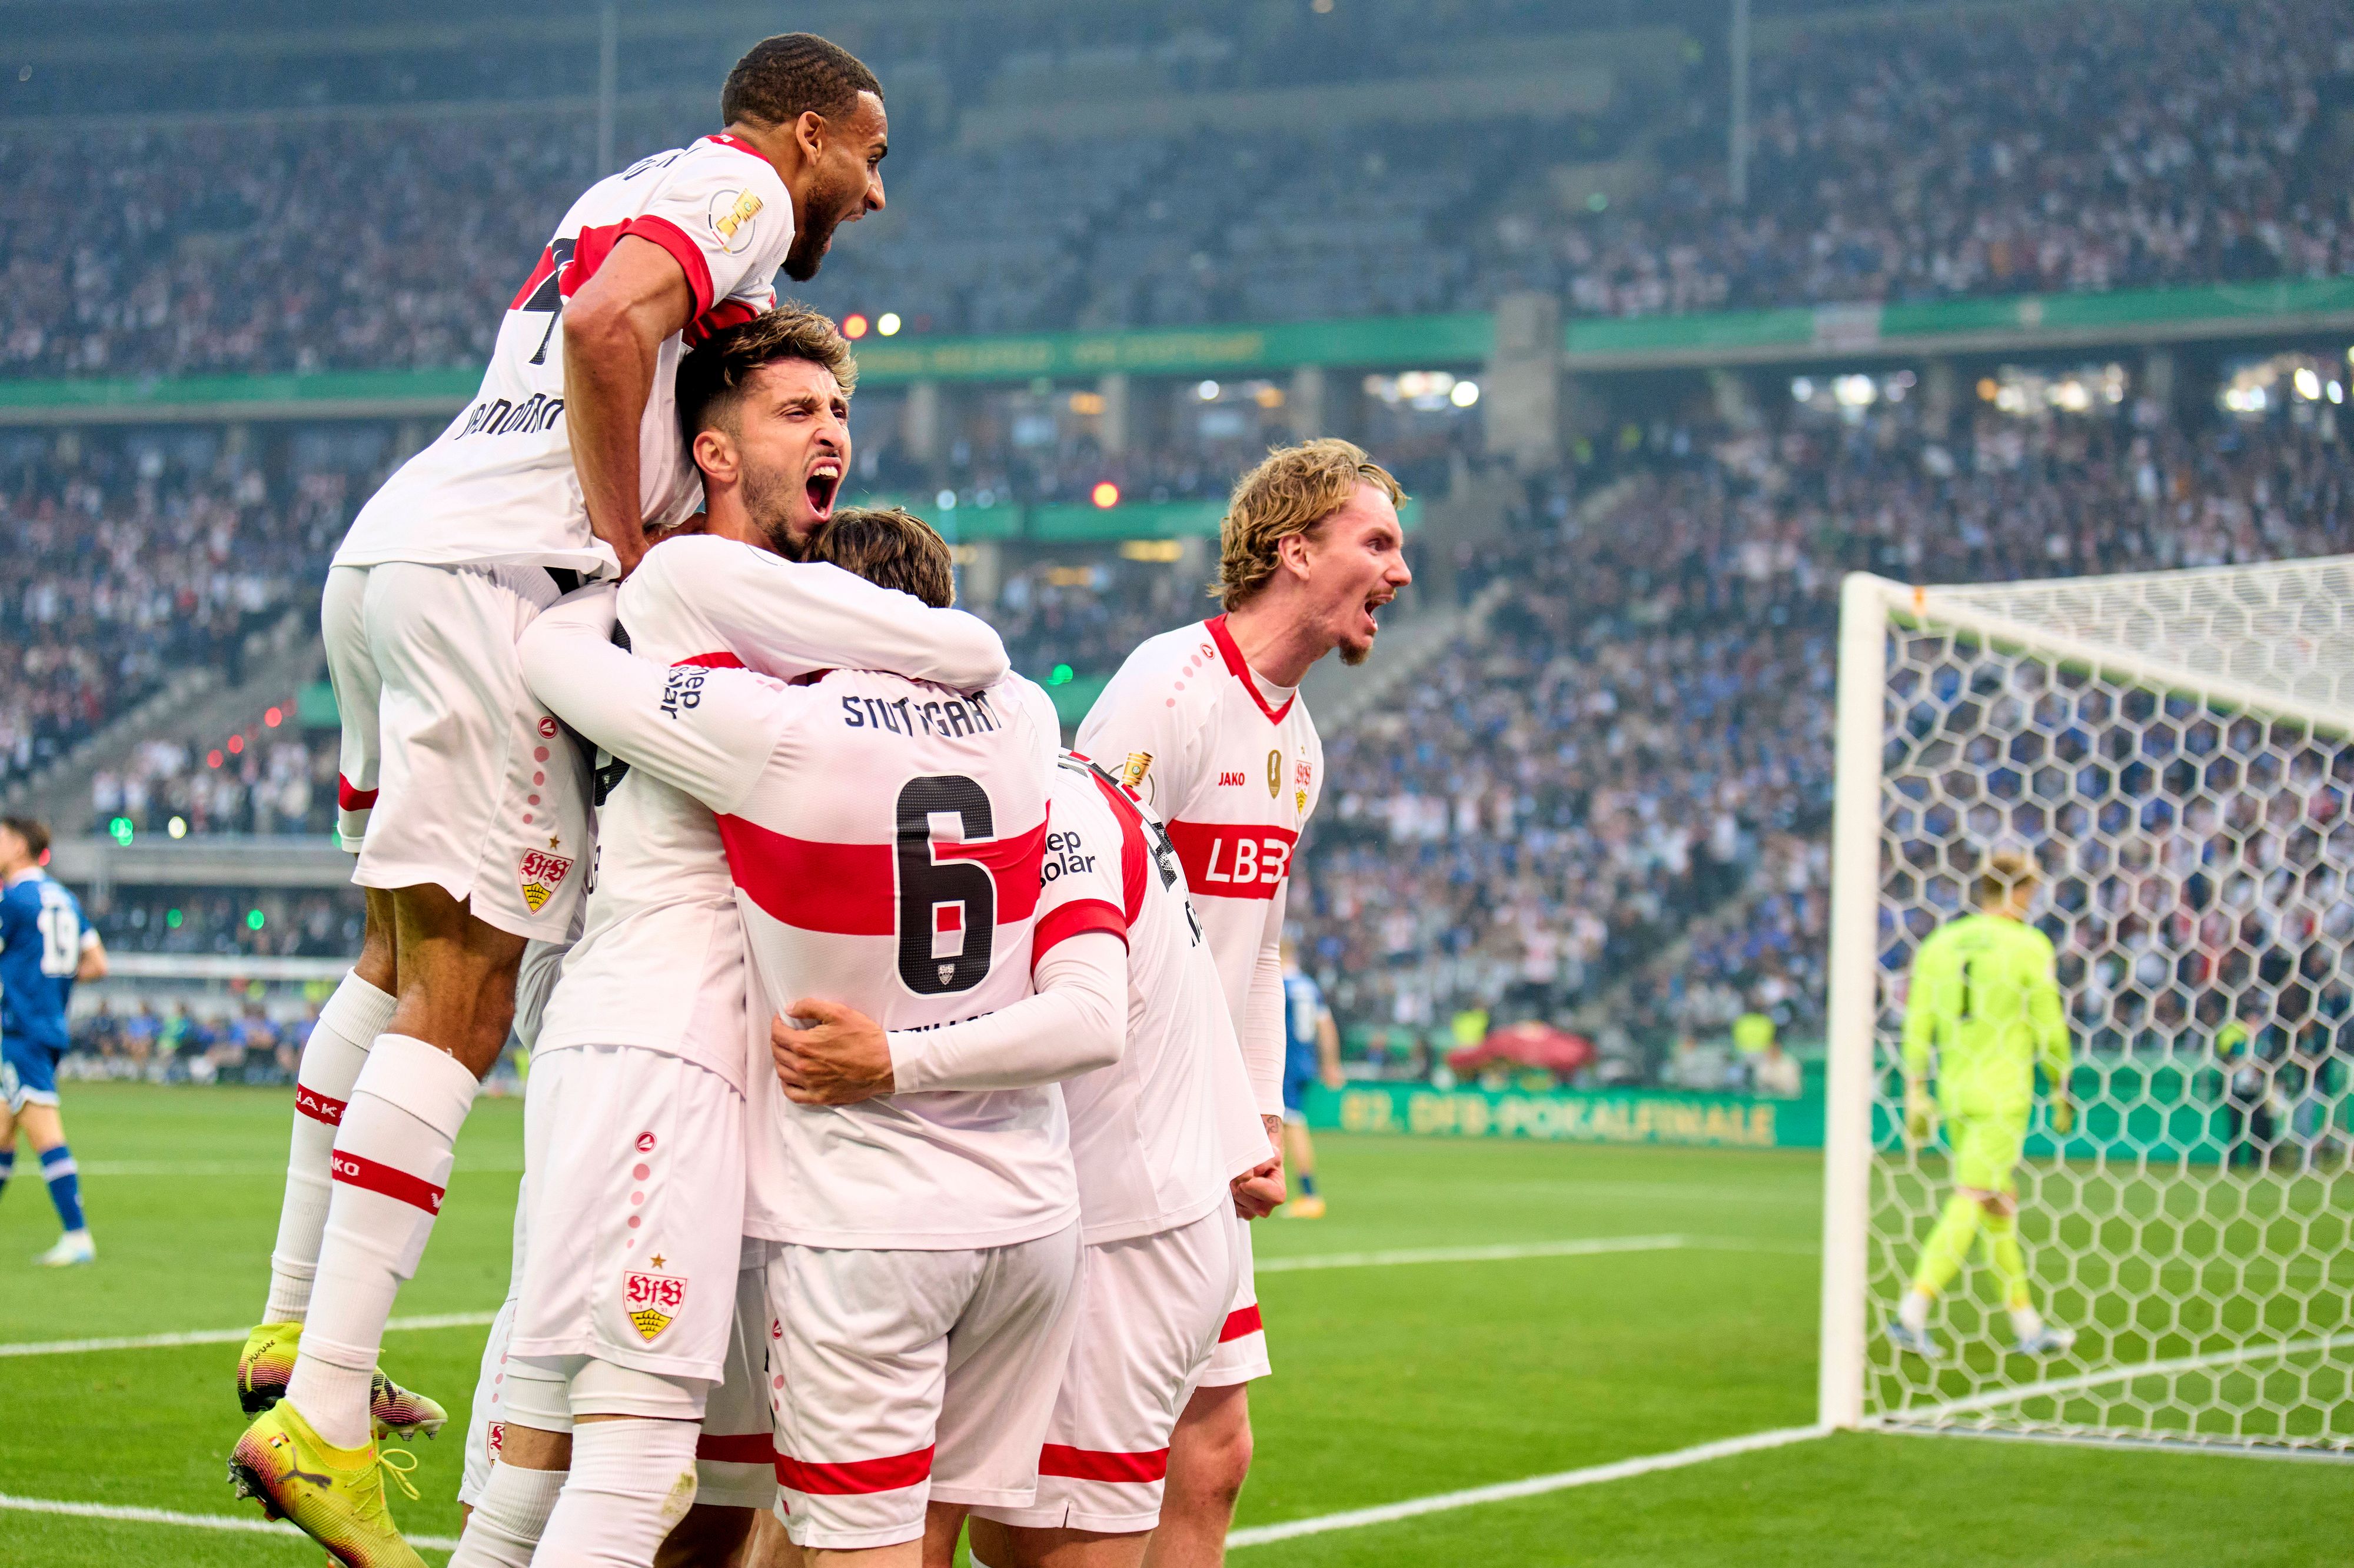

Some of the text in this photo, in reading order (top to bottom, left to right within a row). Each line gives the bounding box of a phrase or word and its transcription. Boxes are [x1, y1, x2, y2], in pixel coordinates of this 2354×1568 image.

[1218, 772, 1245, 787] JAKO
[1045, 831, 1081, 855] ep
[521, 853, 569, 883] VfB
[895, 773, 996, 997] 6
[296, 1090, 344, 1118] JAK
[626, 1276, 683, 1307] VfB
